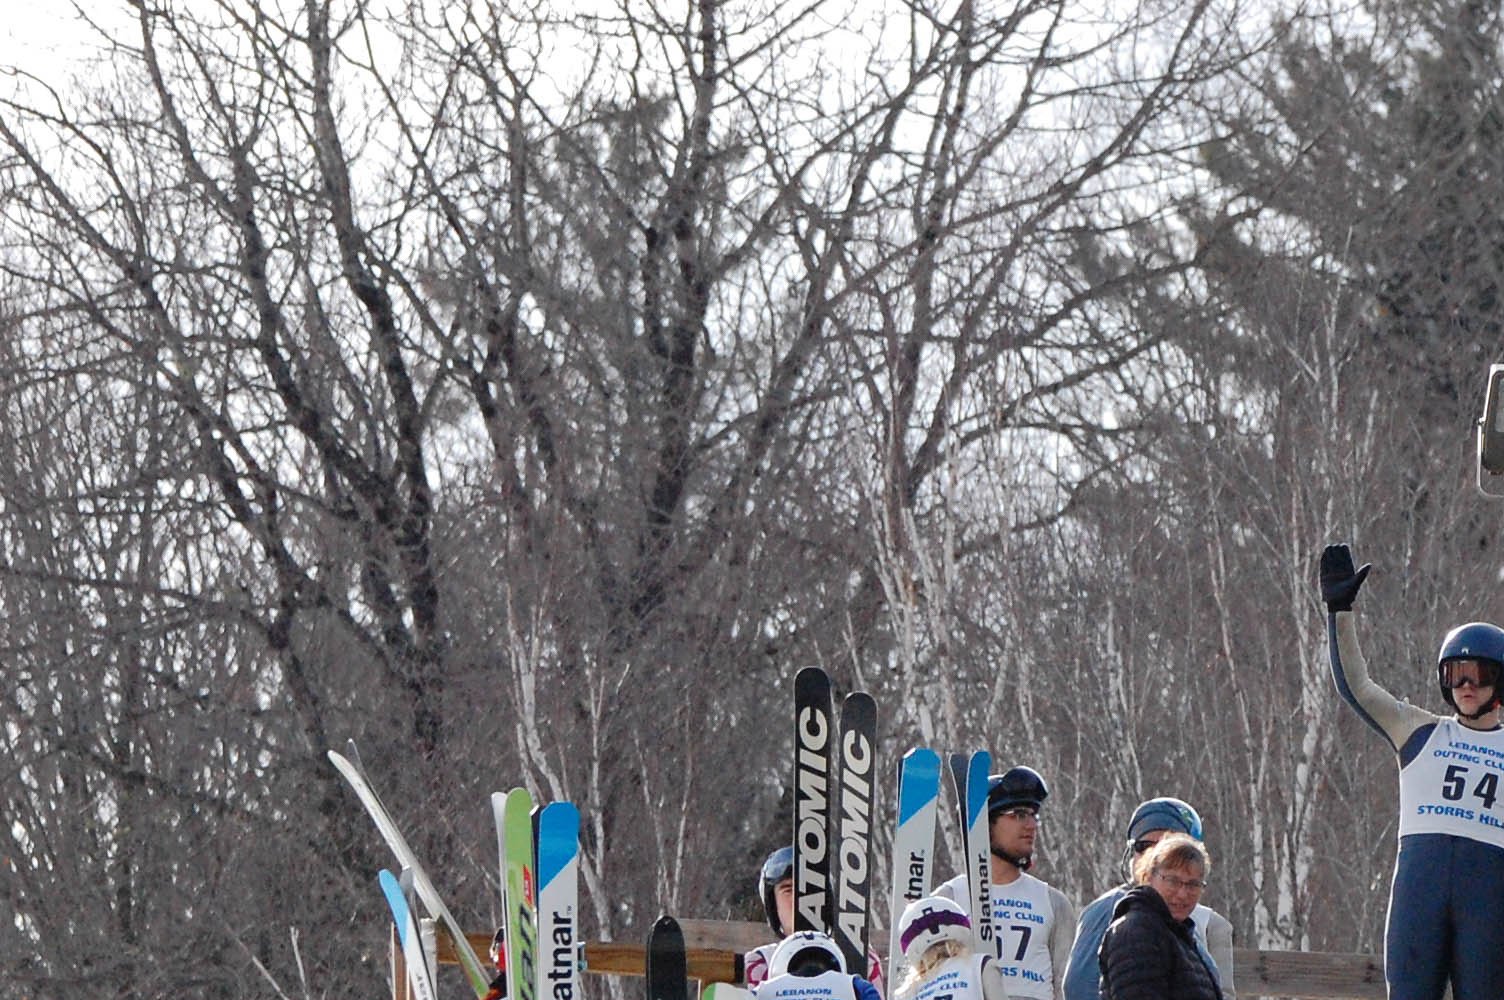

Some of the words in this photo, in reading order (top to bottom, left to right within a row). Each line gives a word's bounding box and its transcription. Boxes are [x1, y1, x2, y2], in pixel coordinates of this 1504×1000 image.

[1433, 749, 1480, 764] OUTING
[1448, 741, 1504, 759] LEBANON
[1442, 764, 1499, 810] 54
[799, 706, 828, 934] ATOMIC
[1417, 804, 1475, 820] STORRS
[838, 730, 870, 957] ATOMIC
[904, 851, 926, 900] tnar
[978, 853, 993, 942] Slatnar
[993, 899, 1032, 910] ANON
[1014, 911, 1045, 925] CLUB
[775, 987, 832, 997] LEBANON
[940, 981, 968, 991] CLUB
